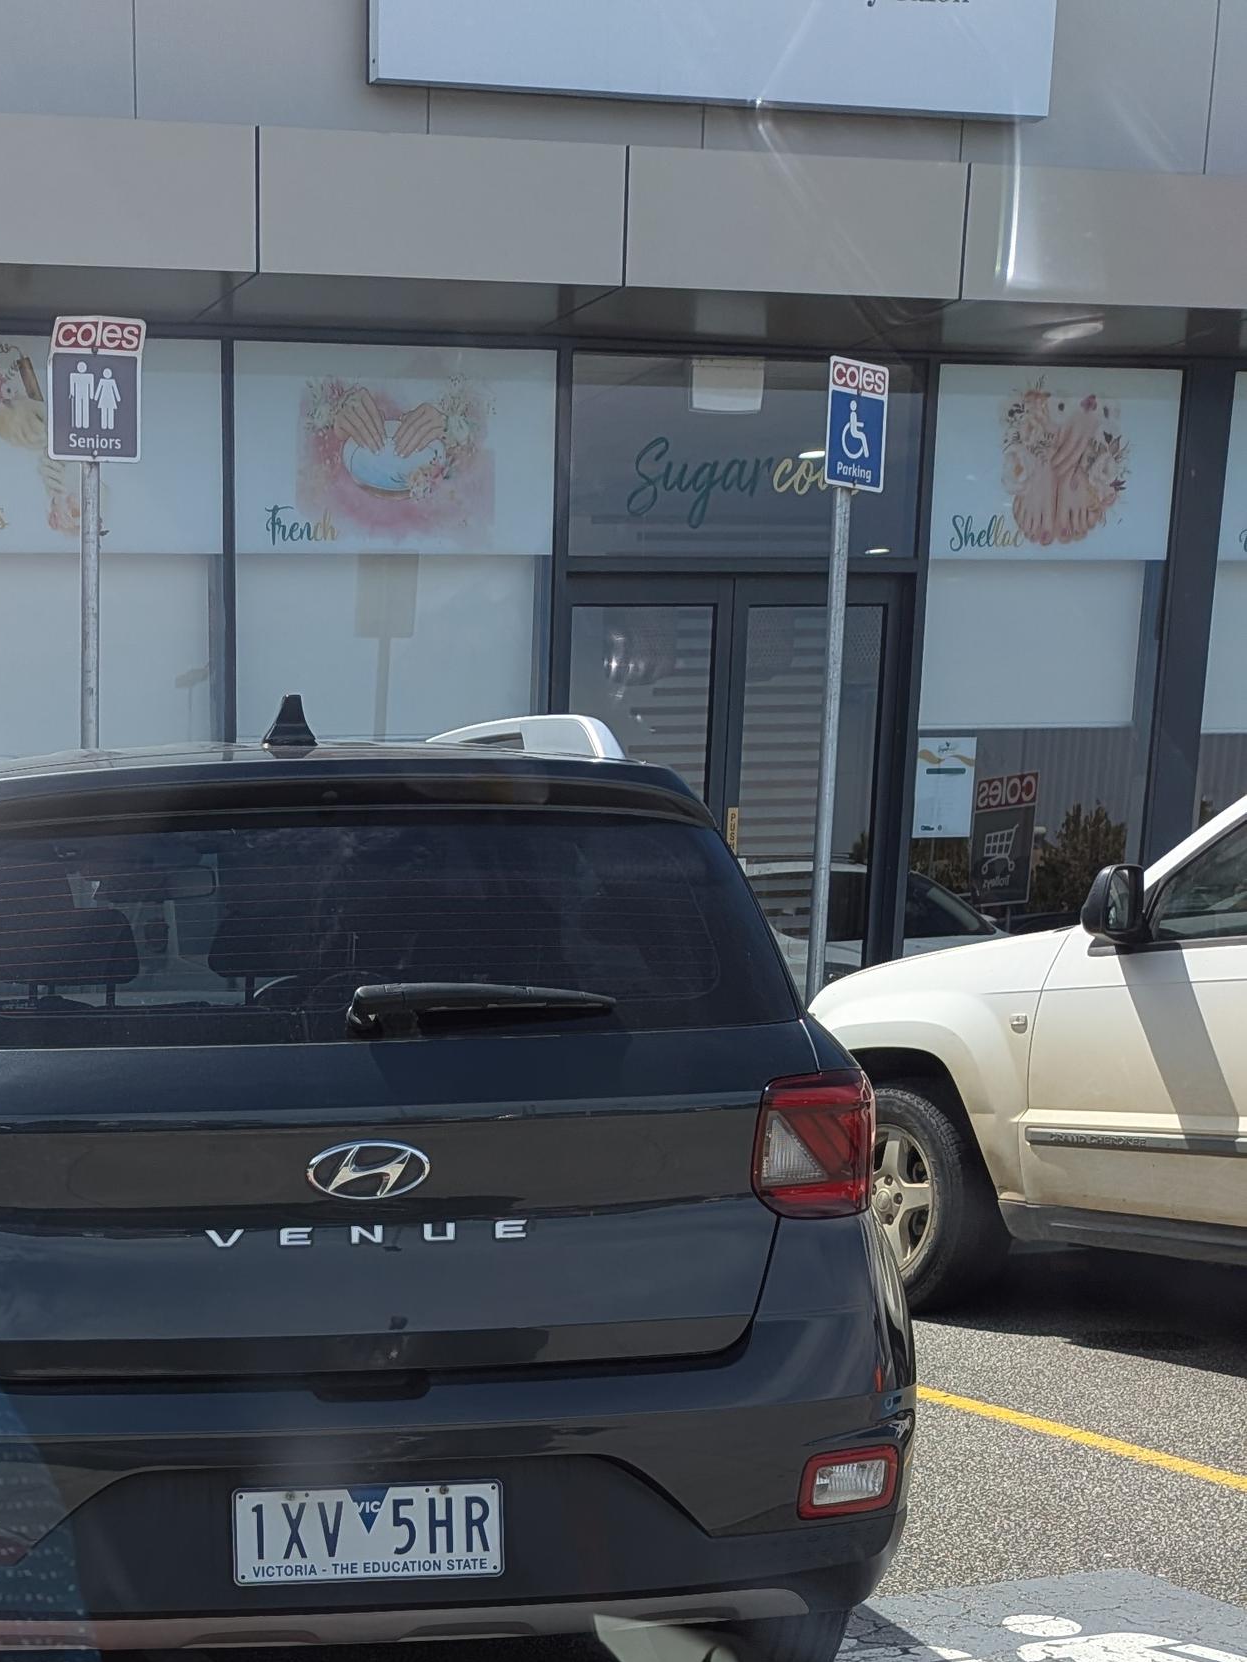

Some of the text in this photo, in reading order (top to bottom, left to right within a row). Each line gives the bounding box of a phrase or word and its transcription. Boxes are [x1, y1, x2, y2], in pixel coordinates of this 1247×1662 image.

[57, 320, 139, 349] coles
[834, 363, 885, 393] coles
[69, 433, 122, 450] Seniors
[836, 461, 872, 483] Parking
[264, 504, 337, 546] French
[949, 514, 1024, 552] Shellac
[204, 1219, 528, 1248] VENUE
[251, 1495, 491, 1560] 1XV VIC 5HR
[253, 1565, 317, 1578] VICTORIA
[332, 1563, 358, 1575] THE
[363, 1560, 441, 1574] EDUCATION
[446, 1558, 488, 1571] STATE
